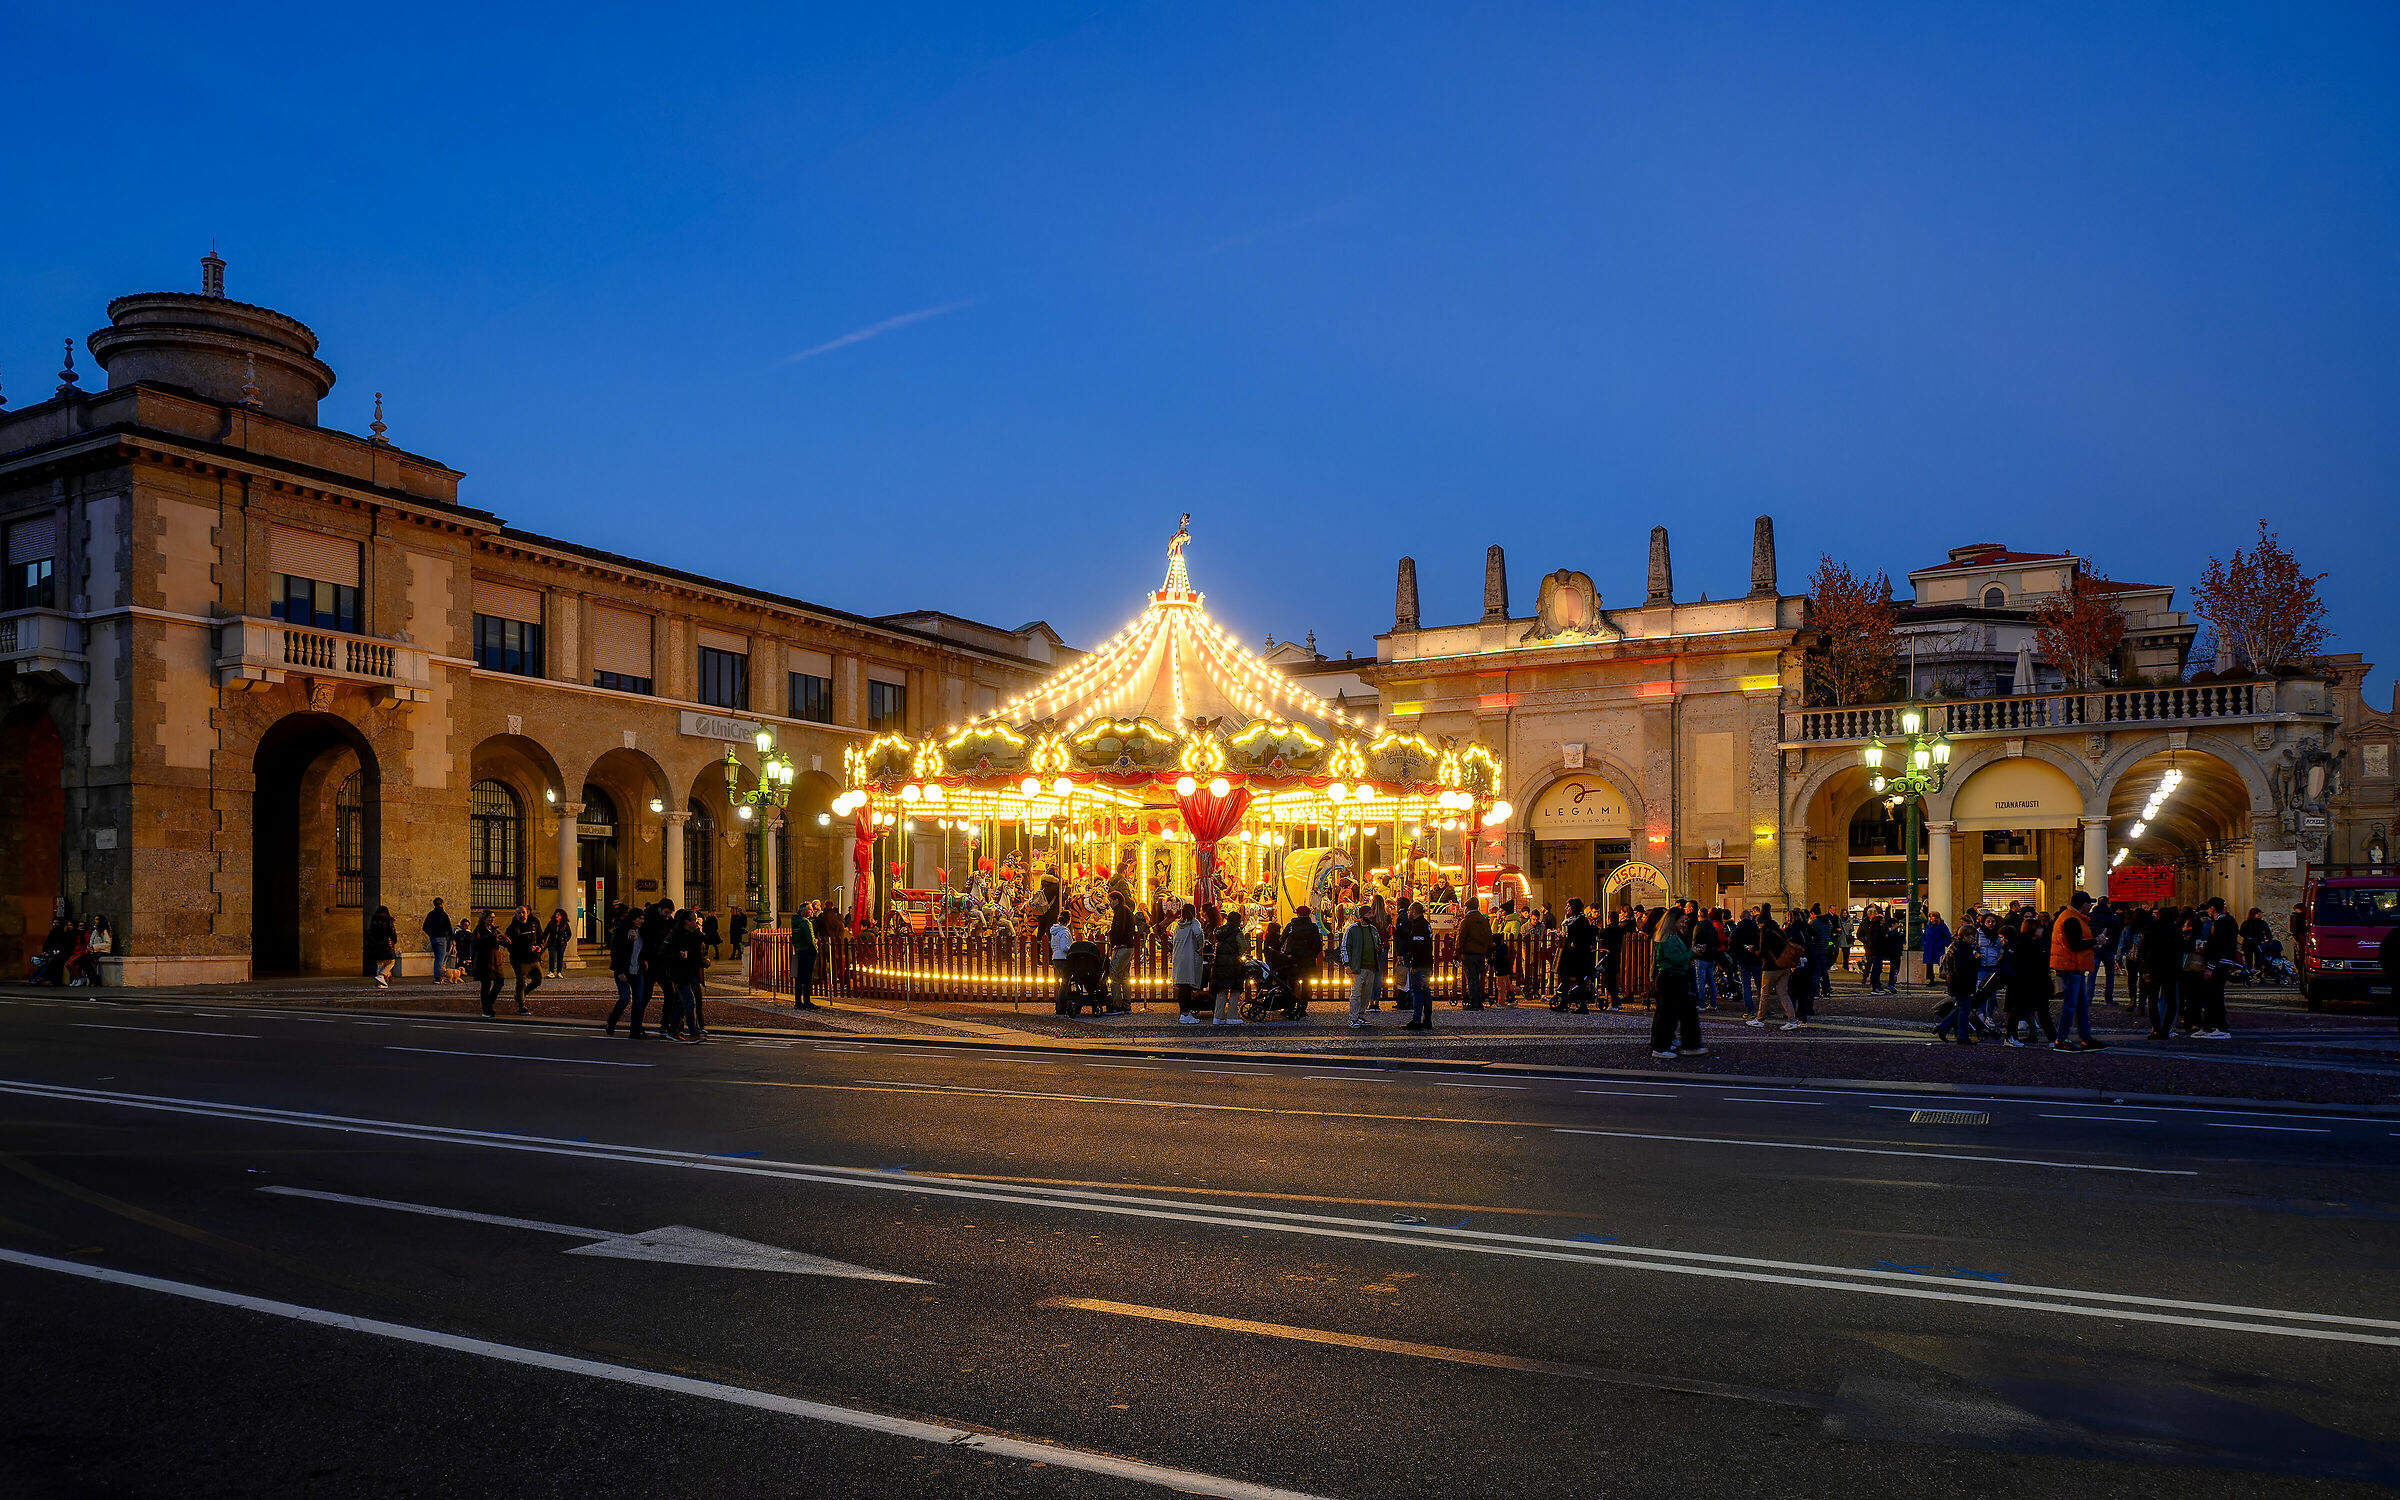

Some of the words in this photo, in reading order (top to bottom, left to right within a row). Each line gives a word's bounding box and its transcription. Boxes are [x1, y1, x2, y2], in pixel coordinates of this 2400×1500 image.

[1994, 800, 2039, 809] TIZIANAFAUSTI
[1545, 806, 1621, 817] LEGAMI
[1613, 866, 1657, 885] USCITA
